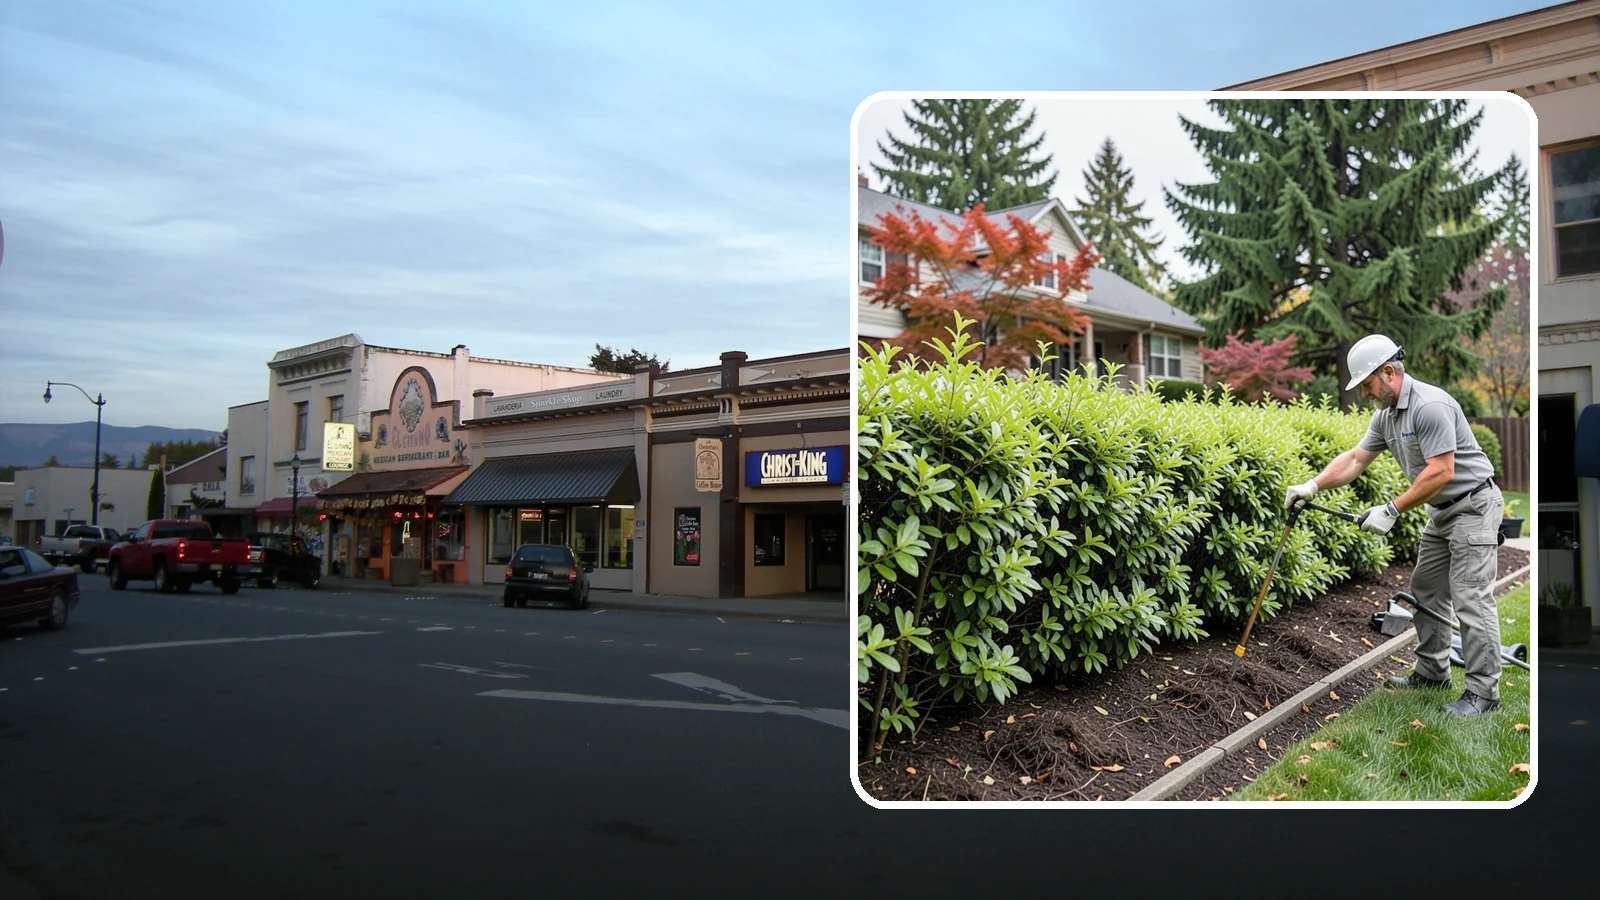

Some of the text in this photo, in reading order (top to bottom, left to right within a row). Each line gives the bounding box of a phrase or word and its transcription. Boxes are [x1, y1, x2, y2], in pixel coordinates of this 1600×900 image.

[595, 389, 624, 400] LAUNDRY
[494, 402, 522, 412] LAVANDERIA
[531, 394, 582, 409] Sparkle Shop
[397, 451, 434, 462] RESTAURANT
[438, 450, 450, 459] BAR
[761, 450, 827, 478] CHRIST KING
